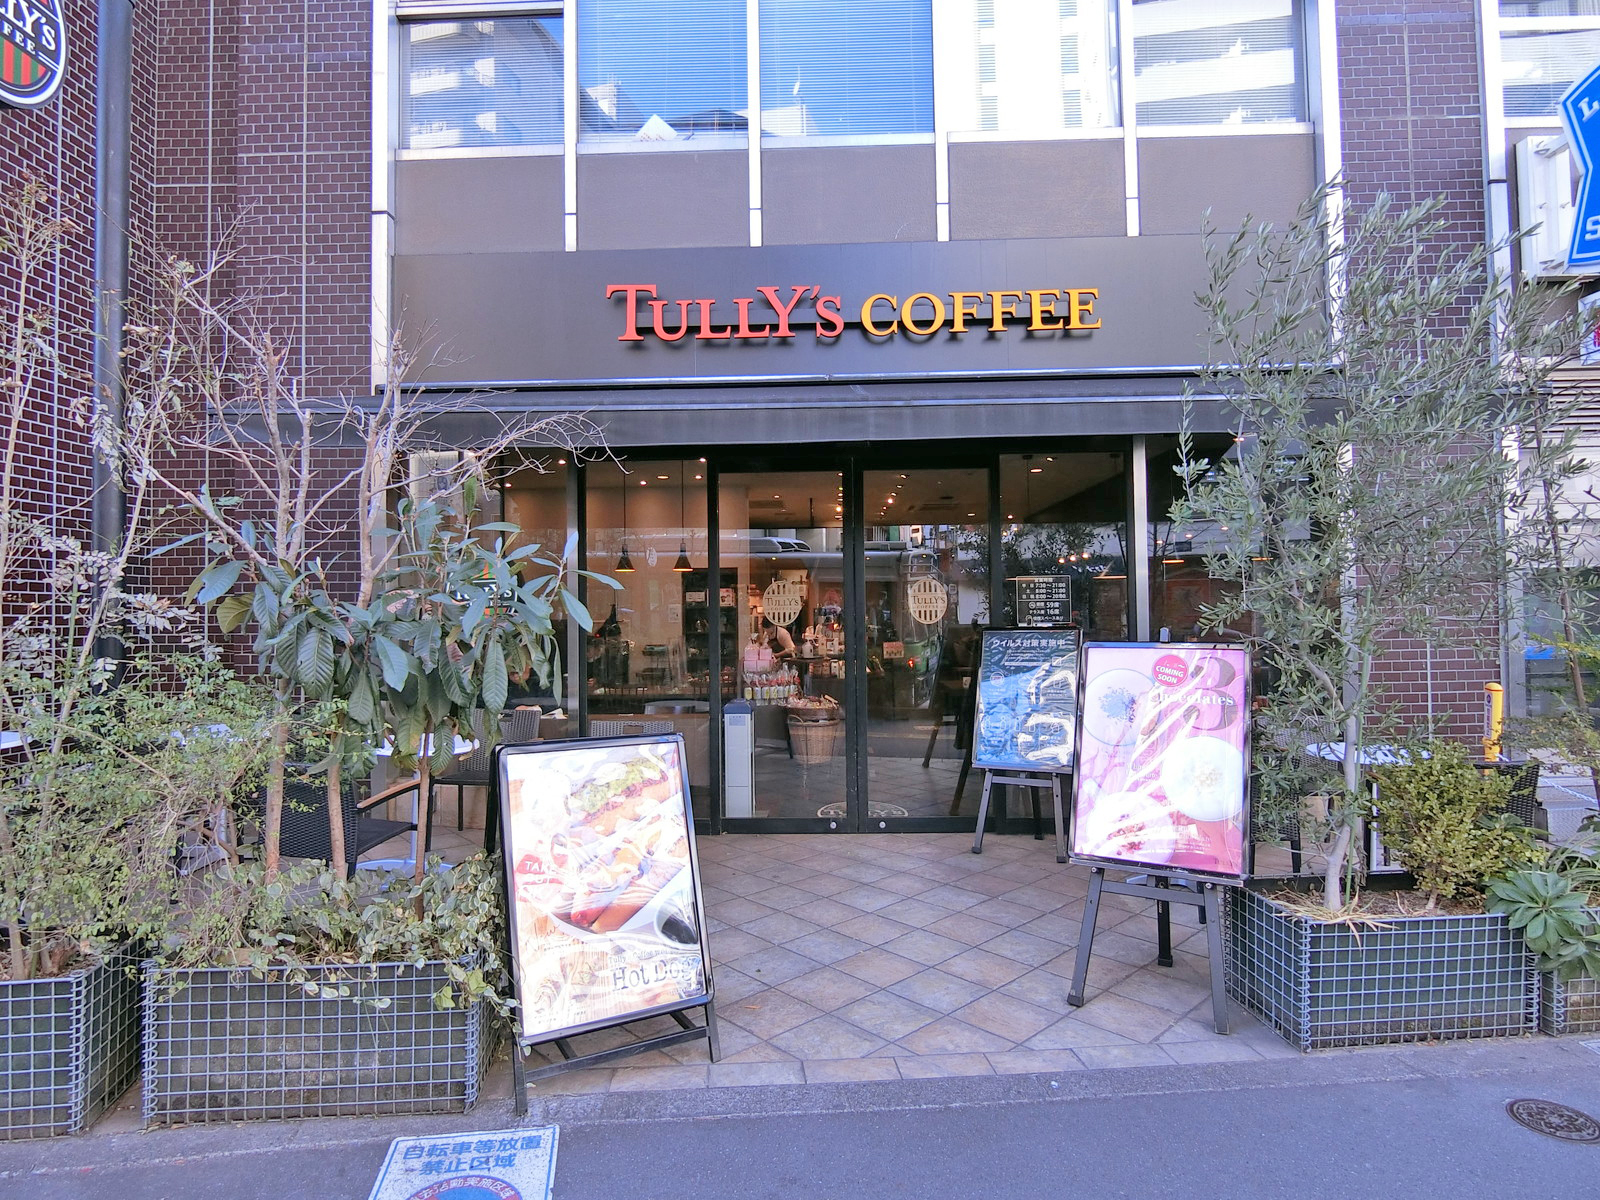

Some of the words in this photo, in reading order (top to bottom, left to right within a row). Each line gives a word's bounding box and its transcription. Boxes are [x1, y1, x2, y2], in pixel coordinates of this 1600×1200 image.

[860, 287, 1103, 337] COFFEE
[1155, 665, 1185, 678] COMING
[1157, 673, 1179, 684] SOON
[611, 964, 650, 992] Hot
[402, 1135, 542, 1160] 自転車等放置
[419, 1153, 517, 1176] 禁止区域
